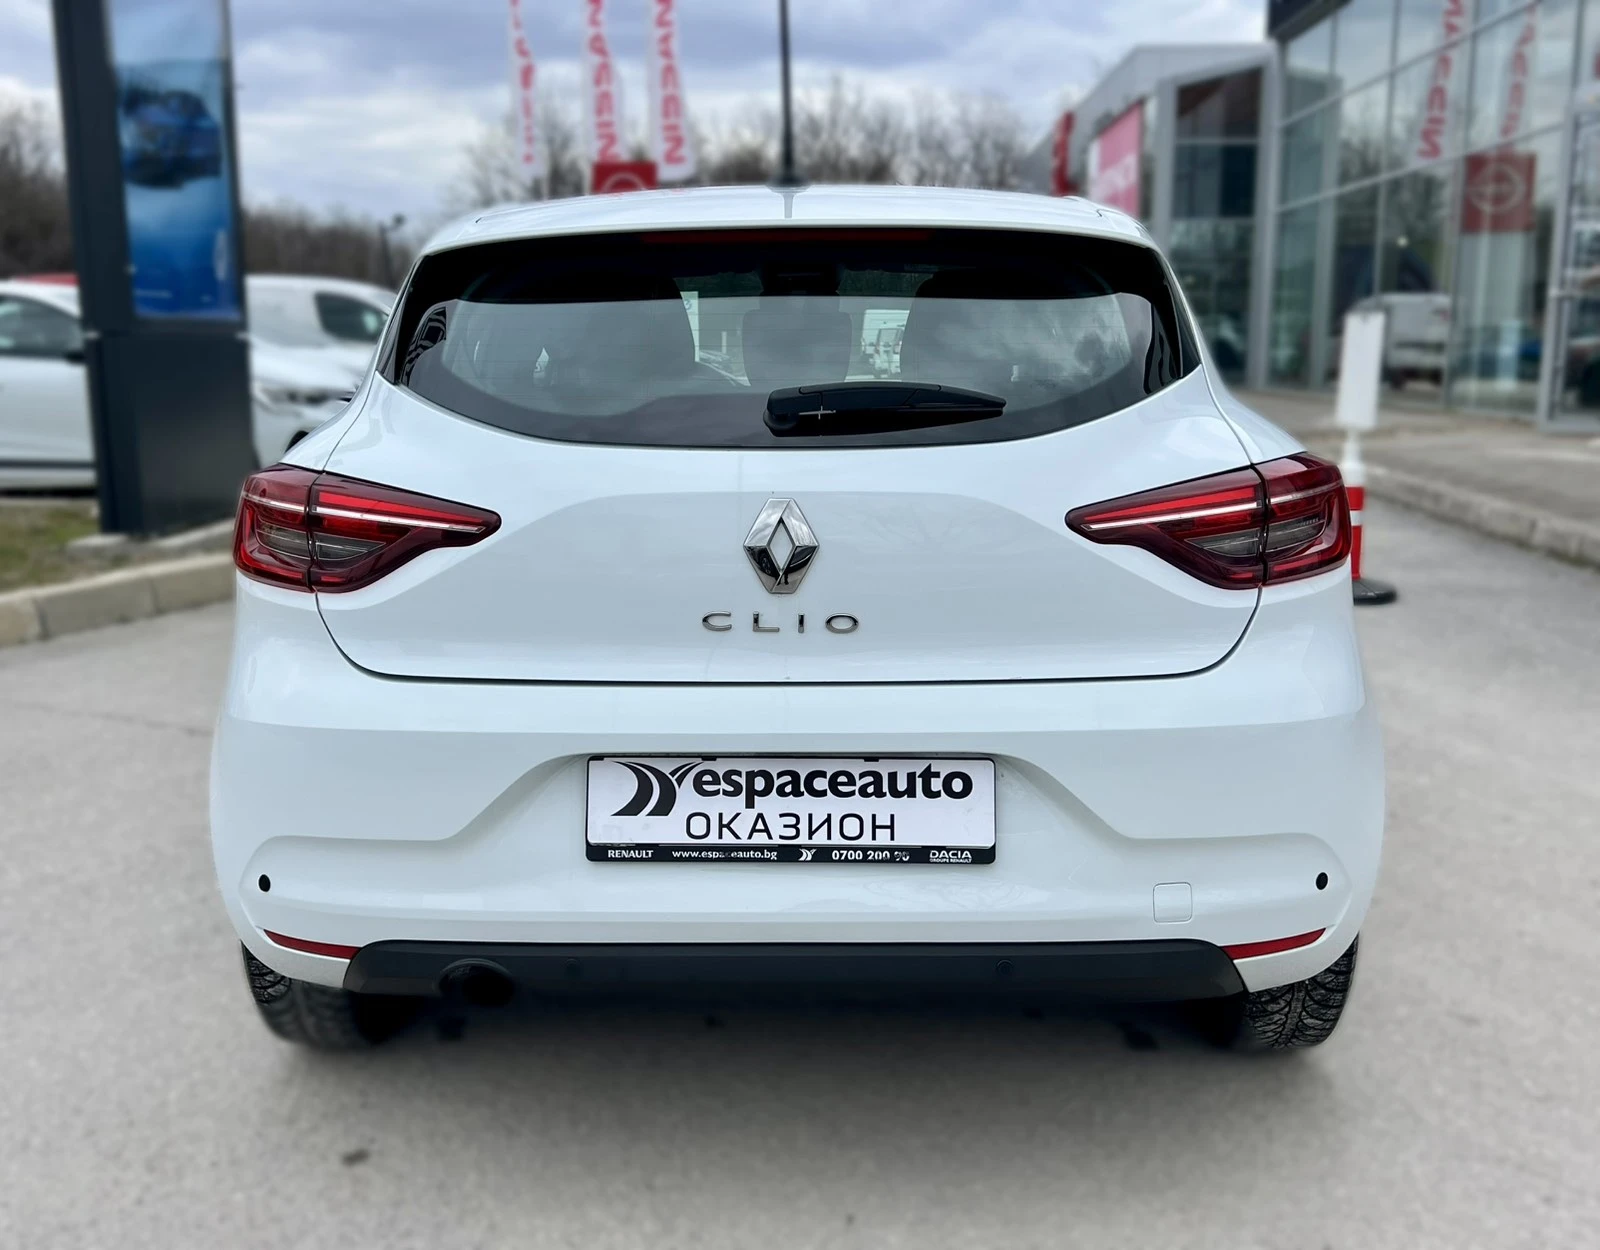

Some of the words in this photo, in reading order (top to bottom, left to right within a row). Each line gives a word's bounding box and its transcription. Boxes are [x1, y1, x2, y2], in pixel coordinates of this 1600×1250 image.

[702, 611, 859, 634] CLIO
[692, 763, 973, 809] espaceauto
[685, 811, 895, 841] ОКАЗИОН
[607, 849, 653, 858] RENAULT
[831, 850, 863, 861] 0700
[866, 850, 890, 861] 200
[929, 850, 972, 858] DACIA
